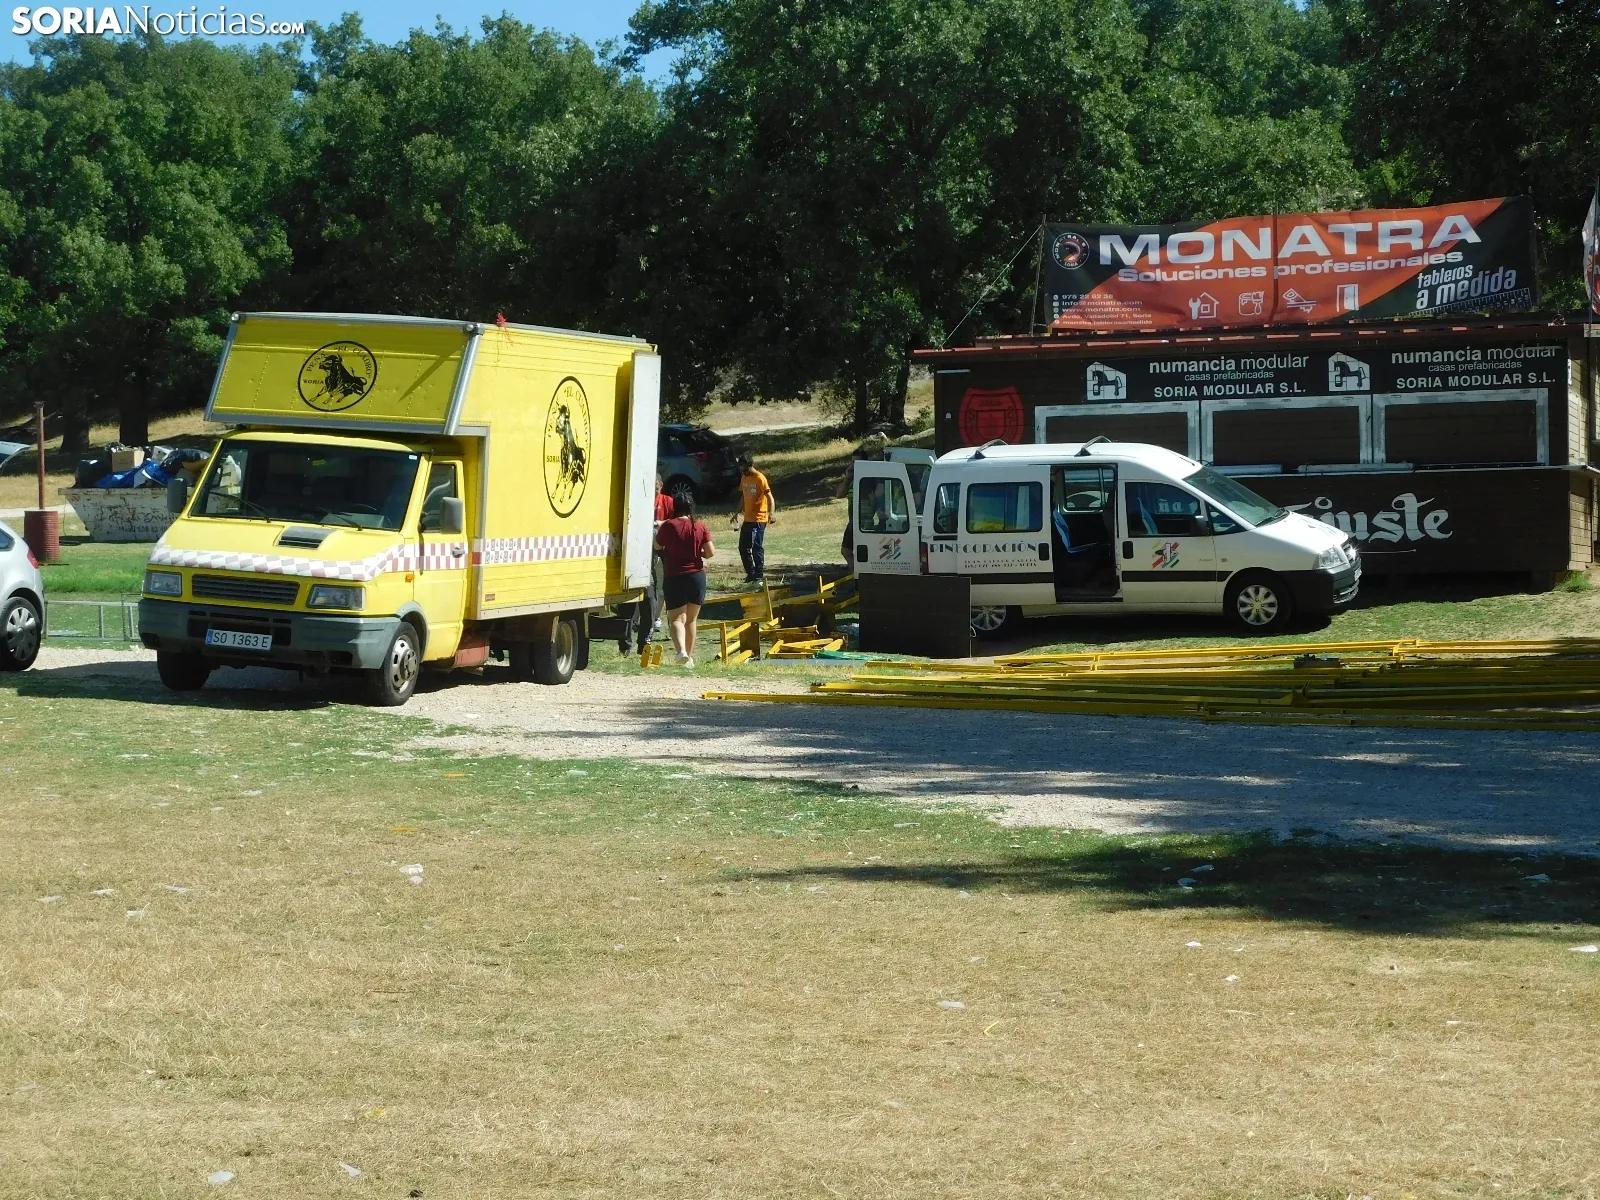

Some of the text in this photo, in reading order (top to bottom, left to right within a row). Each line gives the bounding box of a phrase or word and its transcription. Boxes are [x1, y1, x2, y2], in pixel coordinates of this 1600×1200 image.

[1100, 214, 1482, 266] MONATRA
[1118, 251, 1464, 282] Soluciones profesionales
[1417, 264, 1473, 289] tableros
[1416, 289, 1429, 310] a
[1435, 265, 1516, 305] medida
[1391, 344, 1556, 364] numancia modular
[1149, 353, 1309, 374] numancia modular
[1428, 360, 1522, 372] casas prefabricadas
[1184, 370, 1274, 382] casas prefabricadas
[1396, 372, 1555, 389] SORIA MODULAR S.L.
[1154, 381, 1306, 398] SORIA MODULAR S.L.
[546, 455, 560, 463] SORIA
[213, 632, 269, 648] SO 1363 E
